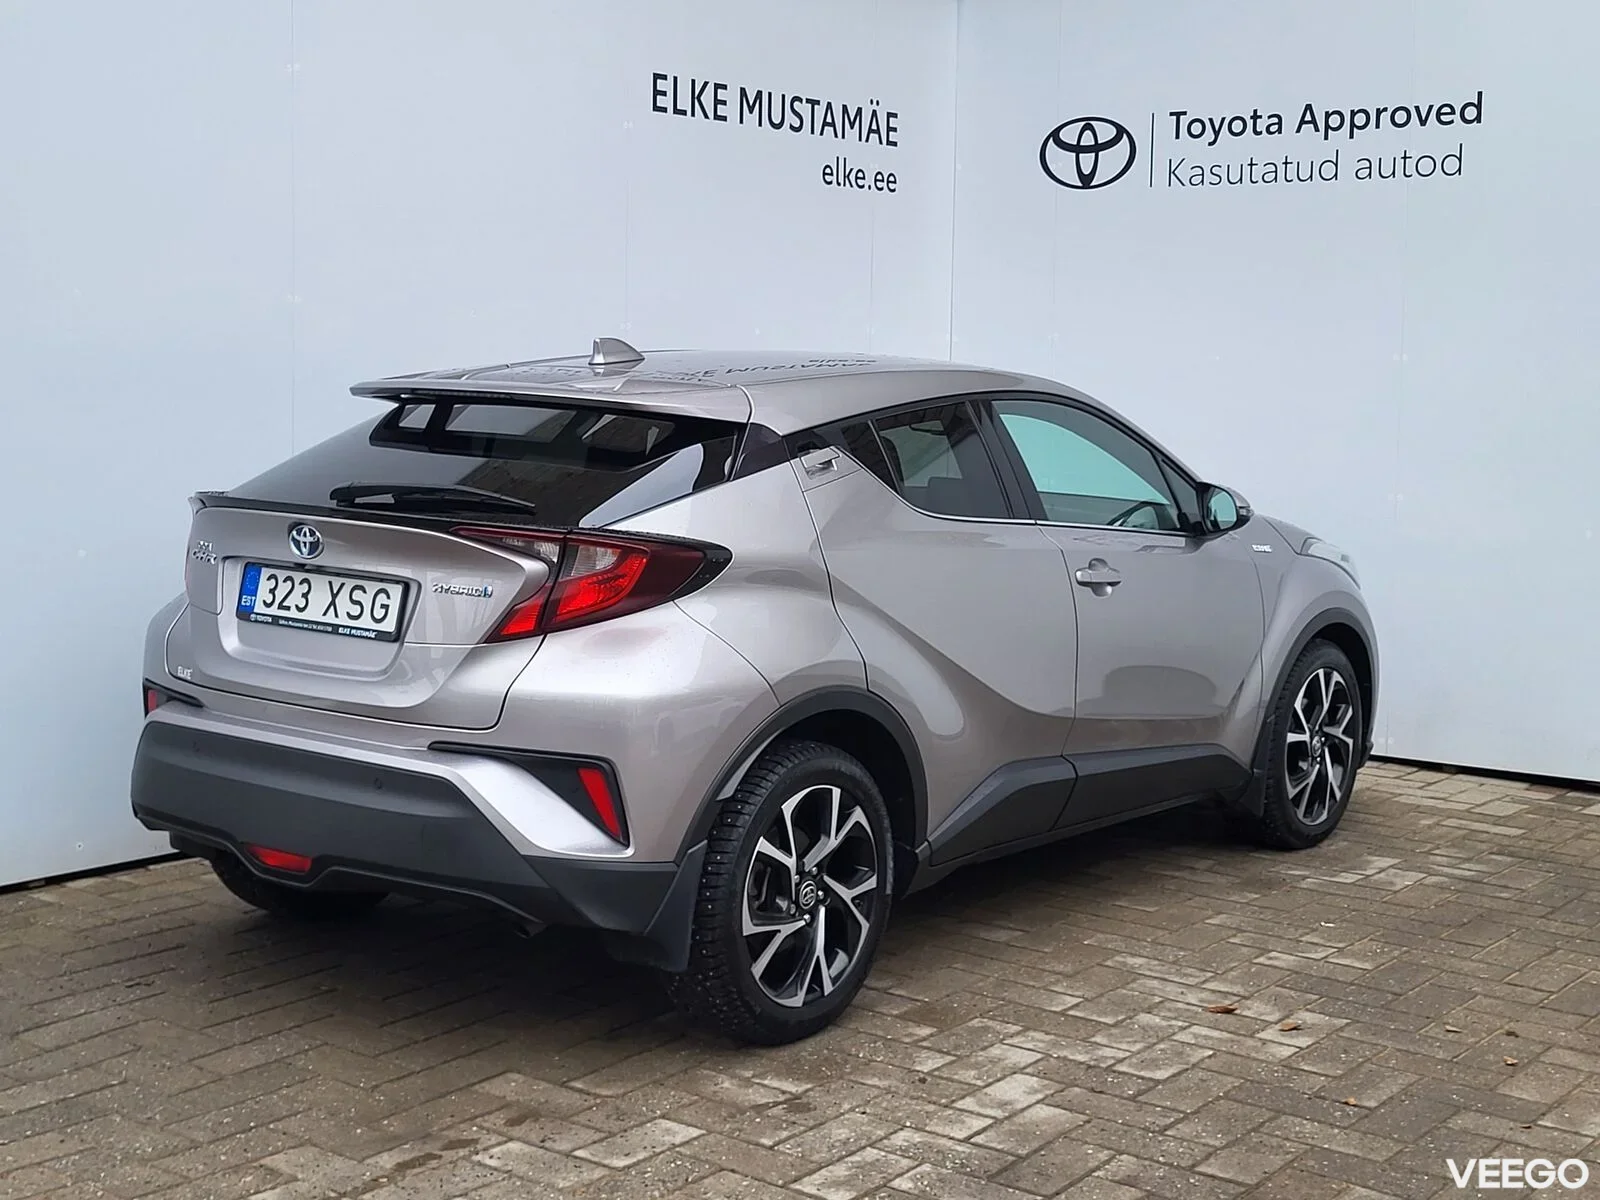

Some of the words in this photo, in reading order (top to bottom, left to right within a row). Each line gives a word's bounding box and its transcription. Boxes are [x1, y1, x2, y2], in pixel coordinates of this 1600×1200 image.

[652, 72, 728, 122] ELKE
[739, 87, 898, 147] MUSTAMÄE
[1169, 108, 1284, 147] Toyota
[1296, 91, 1484, 141] Approved
[822, 156, 897, 193] elke.ee
[1167, 149, 1340, 188] Kasutatud
[1354, 143, 1463, 181] autod
[241, 595, 256, 606] EST
[262, 574, 312, 613] 323
[322, 581, 391, 624] XSG
[432, 582, 483, 597] HYBRID
